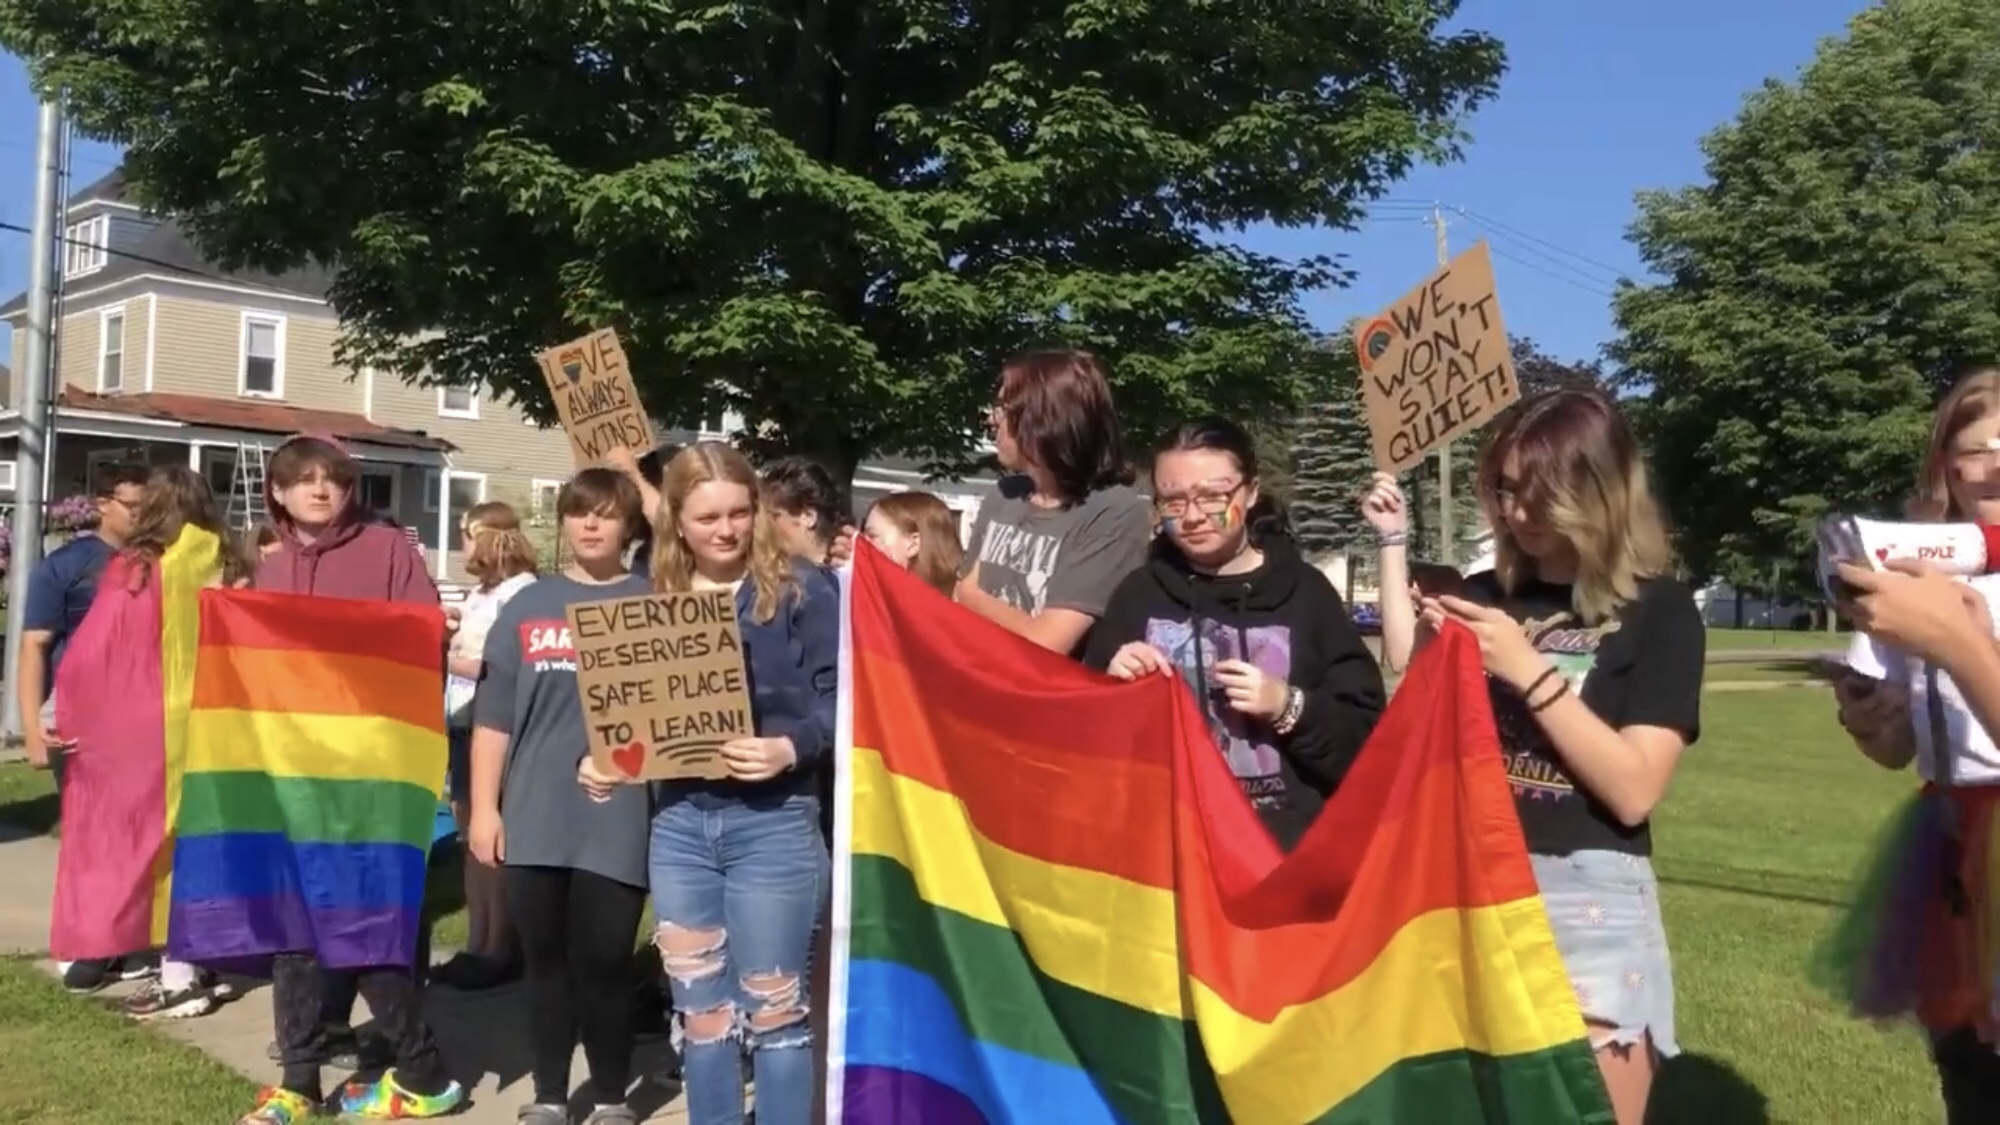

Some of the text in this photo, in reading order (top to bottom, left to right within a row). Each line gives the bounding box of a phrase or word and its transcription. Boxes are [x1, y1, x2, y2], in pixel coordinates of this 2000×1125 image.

[1373, 293, 1493, 398] WON'T
[568, 376, 627, 420] ALWAYS
[1400, 339, 1482, 425] STAY
[574, 412, 649, 460] WINS!
[1389, 363, 1509, 463] QUIET!
[575, 592, 735, 638] EVERYONE
[580, 627, 737, 671] DESERVES A
[587, 668, 742, 712] SAFE PLACE
[596, 709, 746, 746] TO LEARN!
